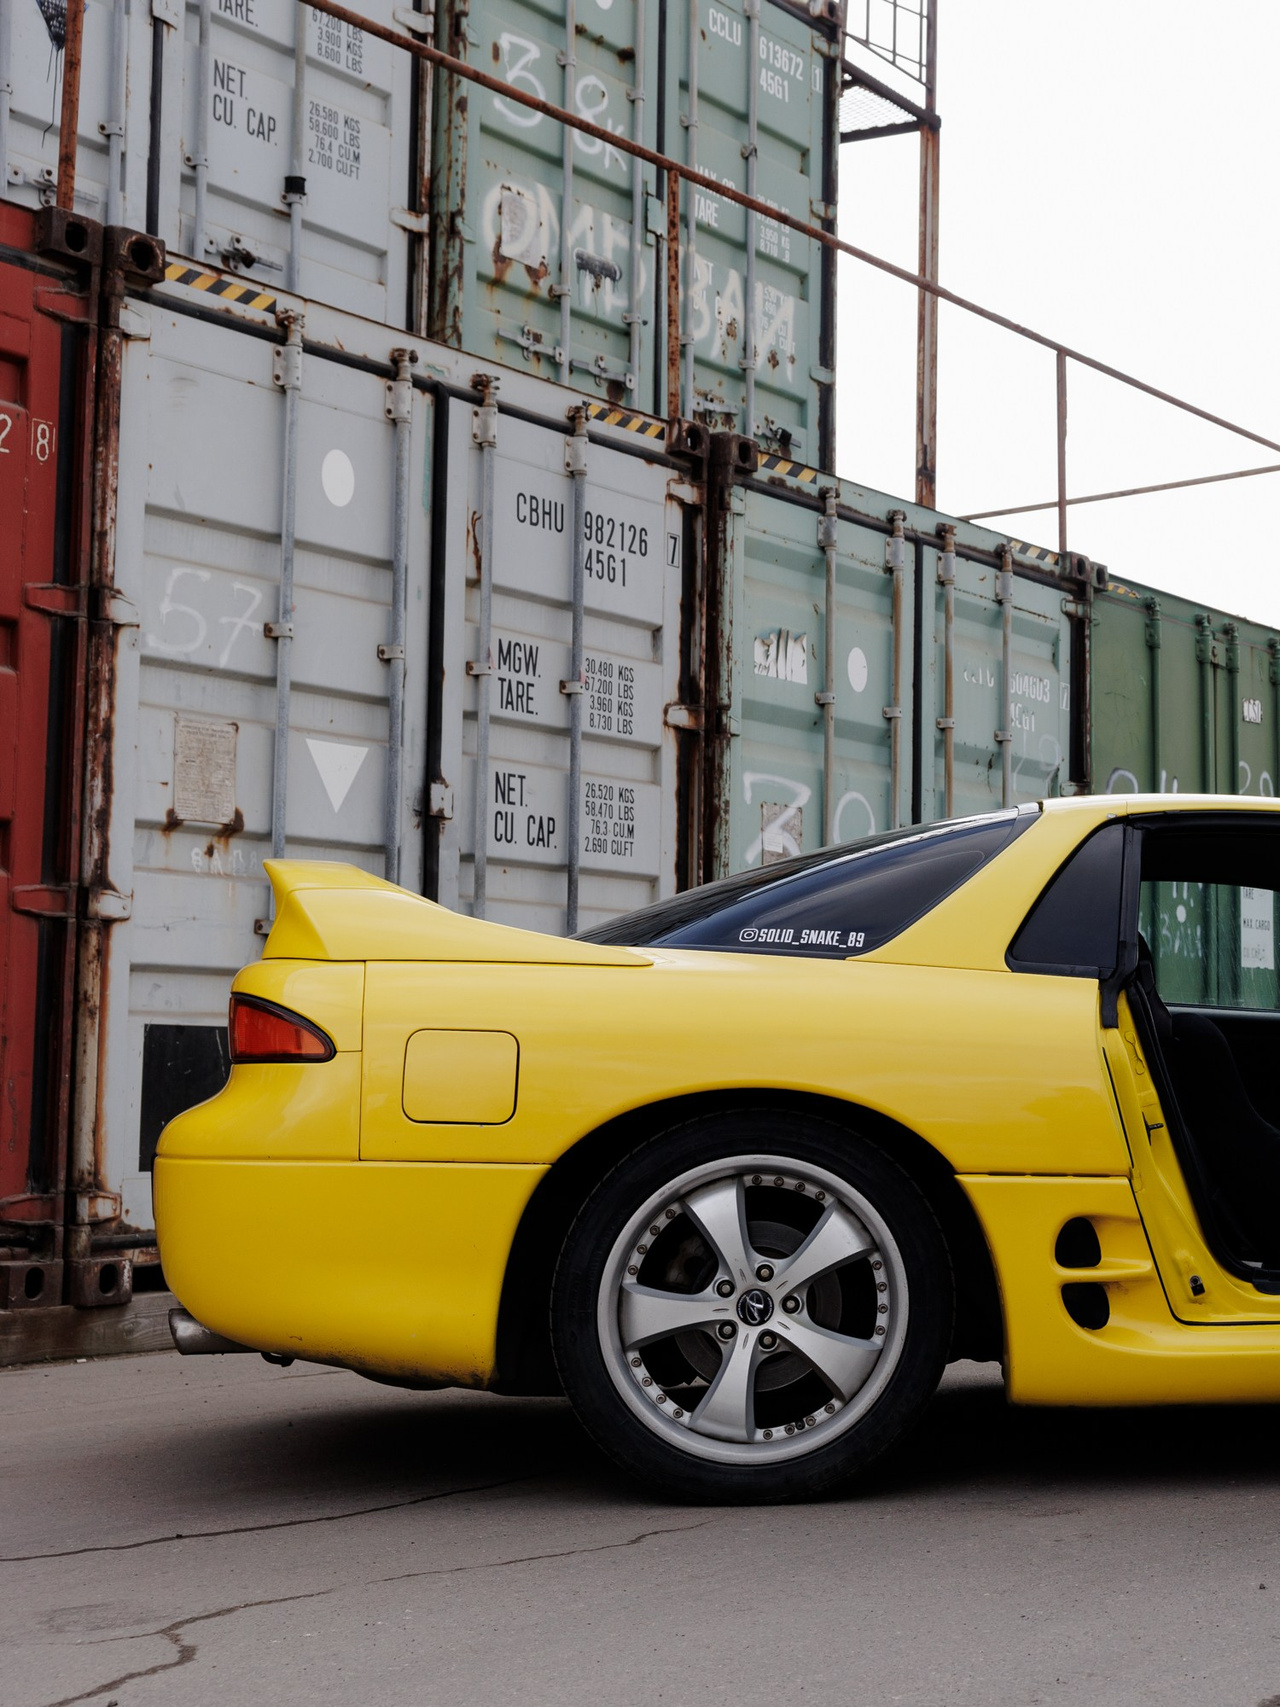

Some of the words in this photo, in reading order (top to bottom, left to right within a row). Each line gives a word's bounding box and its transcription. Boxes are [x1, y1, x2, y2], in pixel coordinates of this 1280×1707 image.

[317, 26, 342, 49] 3.900
[346, 41, 364, 59] KGS
[708, 7, 741, 47] CCLU
[759, 35, 804, 81] 613672
[317, 43, 342, 65] 8.600
[346, 58, 363, 75] LBS
[213, 59, 248, 100] NET.
[760, 67, 788, 103] 45G1
[213, 94, 237, 129] CU.
[247, 108, 278, 146] CAP.
[309, 101, 339, 125] 26.580
[344, 115, 361, 134] KGS
[309, 118, 339, 140] 58.600
[344, 130, 361, 149] LBS
[308, 148, 333, 170] 2.700
[314, 134, 333, 154] 76.4
[694, 193, 719, 228] TARE
[782, 236, 790, 250] KG
[516, 492, 565, 533] CBHU
[584, 510, 648, 557] 982126
[669, 535, 678, 565] 7
[584, 548, 626, 587] 45G1
[146, 567, 263, 668] 57
[498, 638, 542, 678] MGW.
[584, 658, 614, 679] 30.480
[618, 665, 634, 683] KGS
[497, 676, 539, 715] TARE.
[584, 676, 613, 696] 67.200
[618, 684, 634, 700] LBS
[589, 695, 613, 714] 3.960
[617, 701, 634, 718] KGS
[589, 713, 613, 731] 8.730
[617, 719, 633, 735] LBS
[494, 771, 528, 808] NET.
[585, 783, 614, 801] 26.520
[618, 787, 635, 804] KGS
[585, 801, 614, 819] 58.470
[618, 805, 635, 822] LBS
[494, 811, 518, 844] CU.
[526, 815, 558, 849] CAP.
[590, 819, 608, 836] 76.3
[613, 822, 635, 840] CU.M
[584, 837, 608, 854] 2.690
[611, 840, 634, 857] CU.FT
[758, 928, 866, 947] SOLID_SNAKE_89
